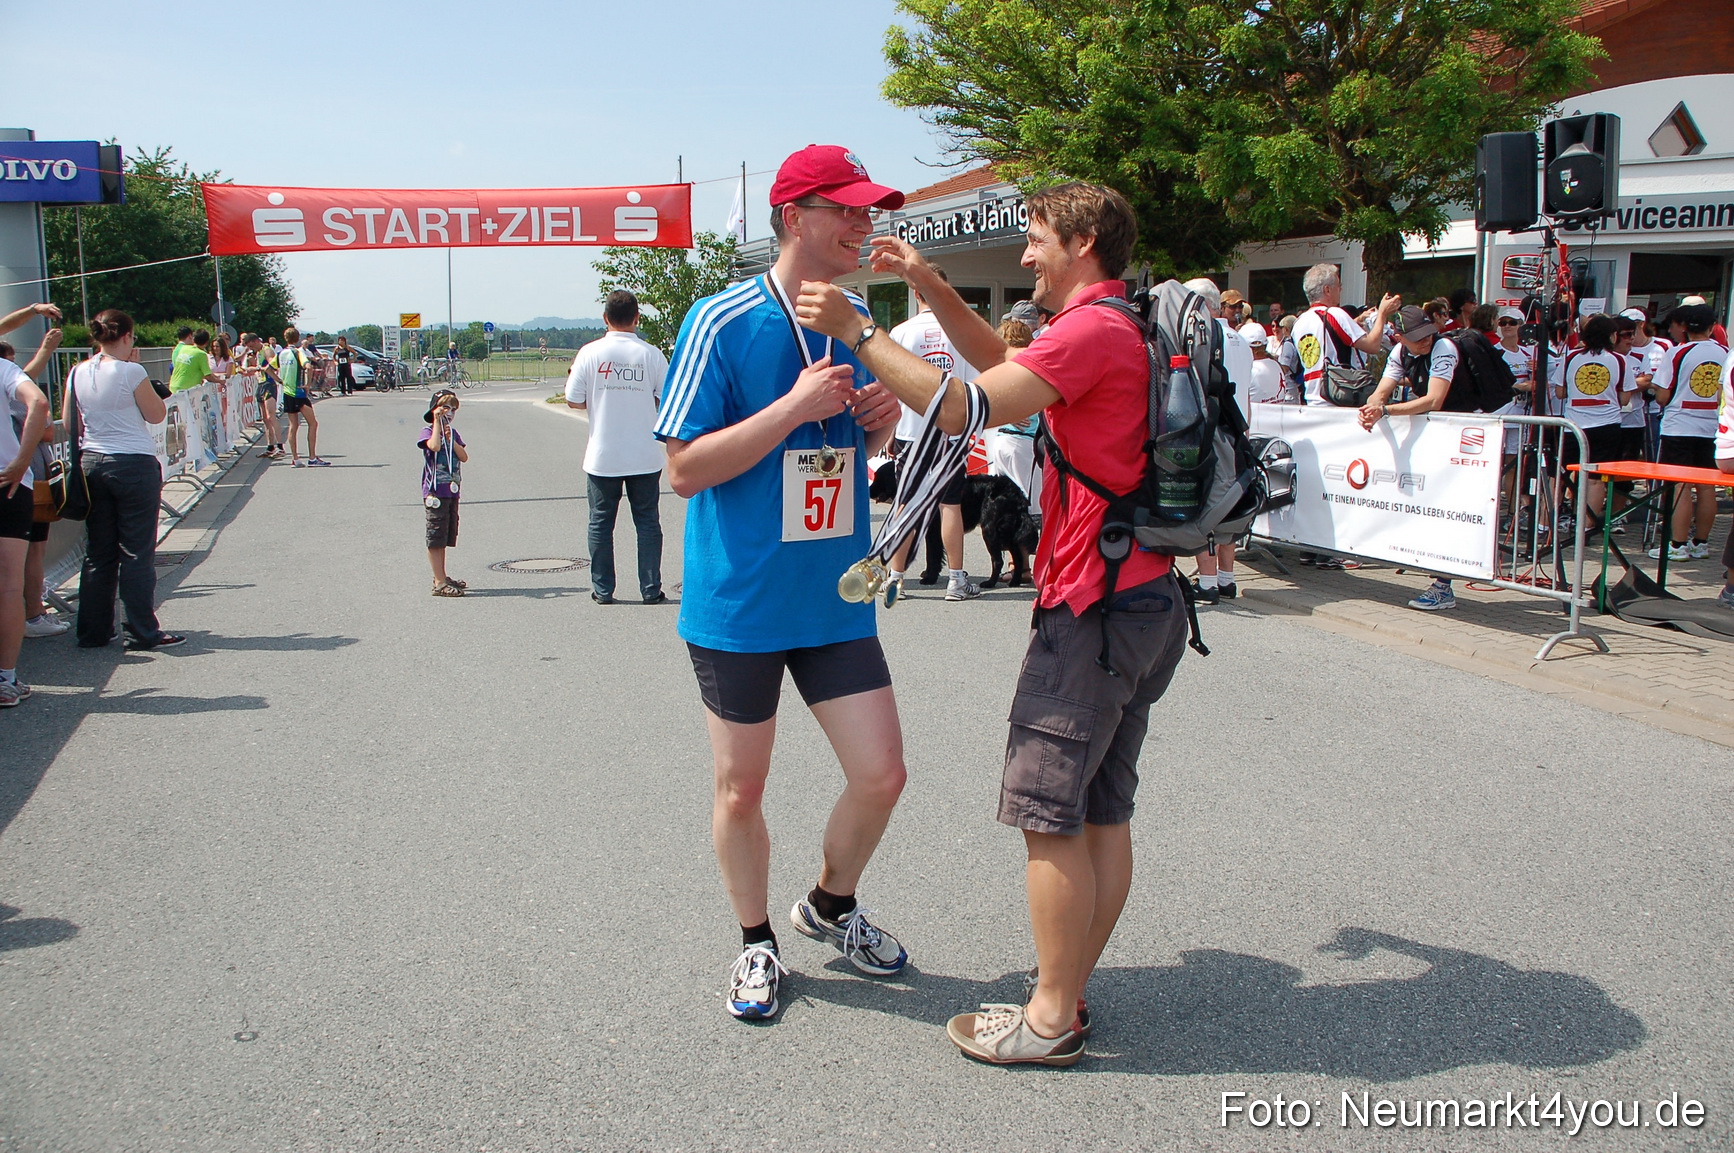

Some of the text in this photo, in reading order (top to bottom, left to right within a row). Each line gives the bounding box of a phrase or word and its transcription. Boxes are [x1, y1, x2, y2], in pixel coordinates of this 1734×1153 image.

[0, 159, 77, 181] LVO
[896, 199, 1030, 244] Gerhart & Jänig
[1495, 299, 1522, 307] SE
[1450, 457, 1489, 468] SEAT
[804, 478, 842, 532] 57
[1321, 492, 1486, 526] MIT EINEM UPGRADE IST DAS LEBEN SCHÖNER.
[1426, 552, 1460, 564] VOLKSWAGEN
[1460, 558, 1483, 568] GRUPPE
